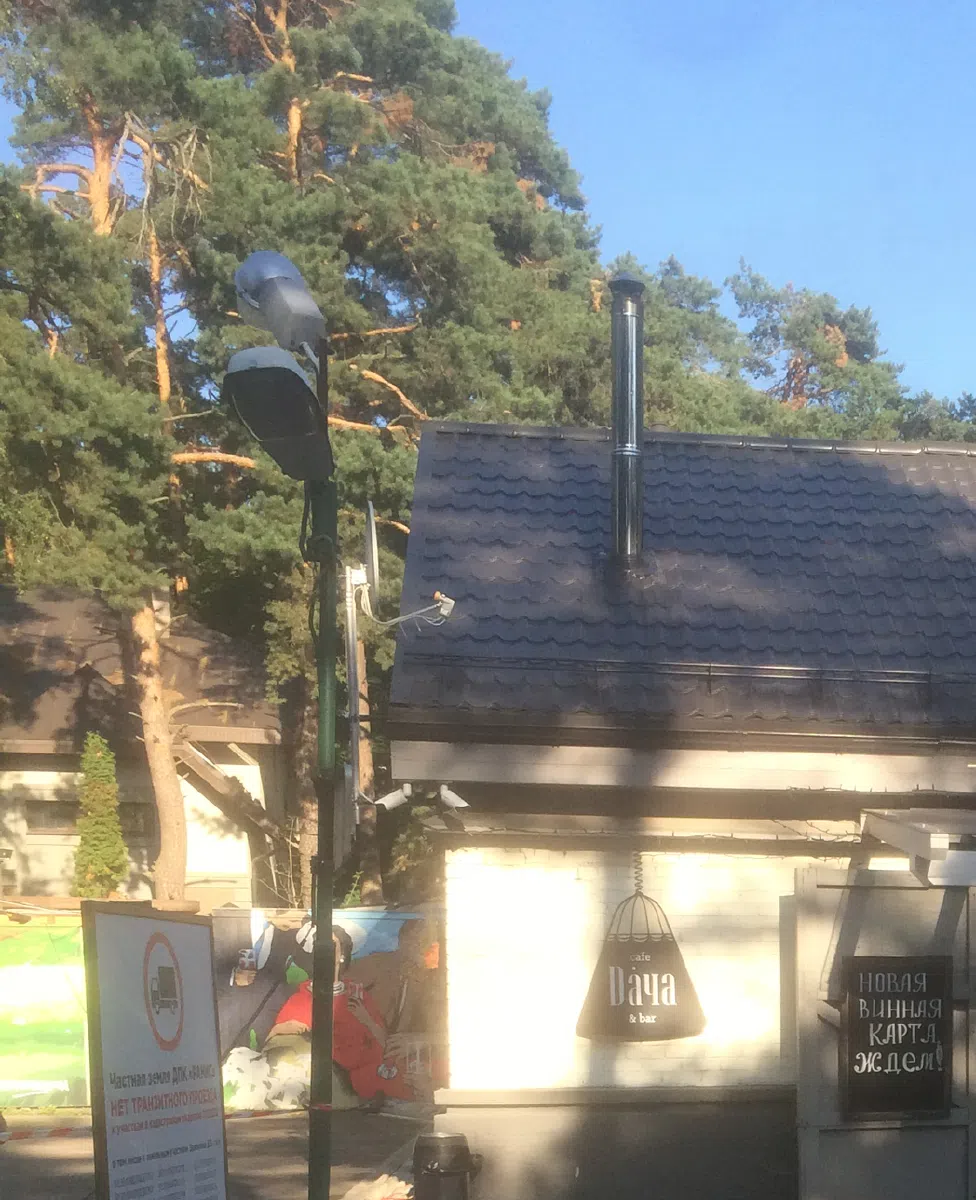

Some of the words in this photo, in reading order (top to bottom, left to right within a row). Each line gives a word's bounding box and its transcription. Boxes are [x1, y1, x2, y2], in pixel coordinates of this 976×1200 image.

[629, 952, 651, 961] cafe
[859, 972, 927, 993] НОВАЯ
[639, 1012, 657, 1023] bar
[859, 998, 942, 1019] ВИННАЯ
[869, 1023, 938, 1046] КАРТА
[110, 1097, 129, 1117] НЕТ
